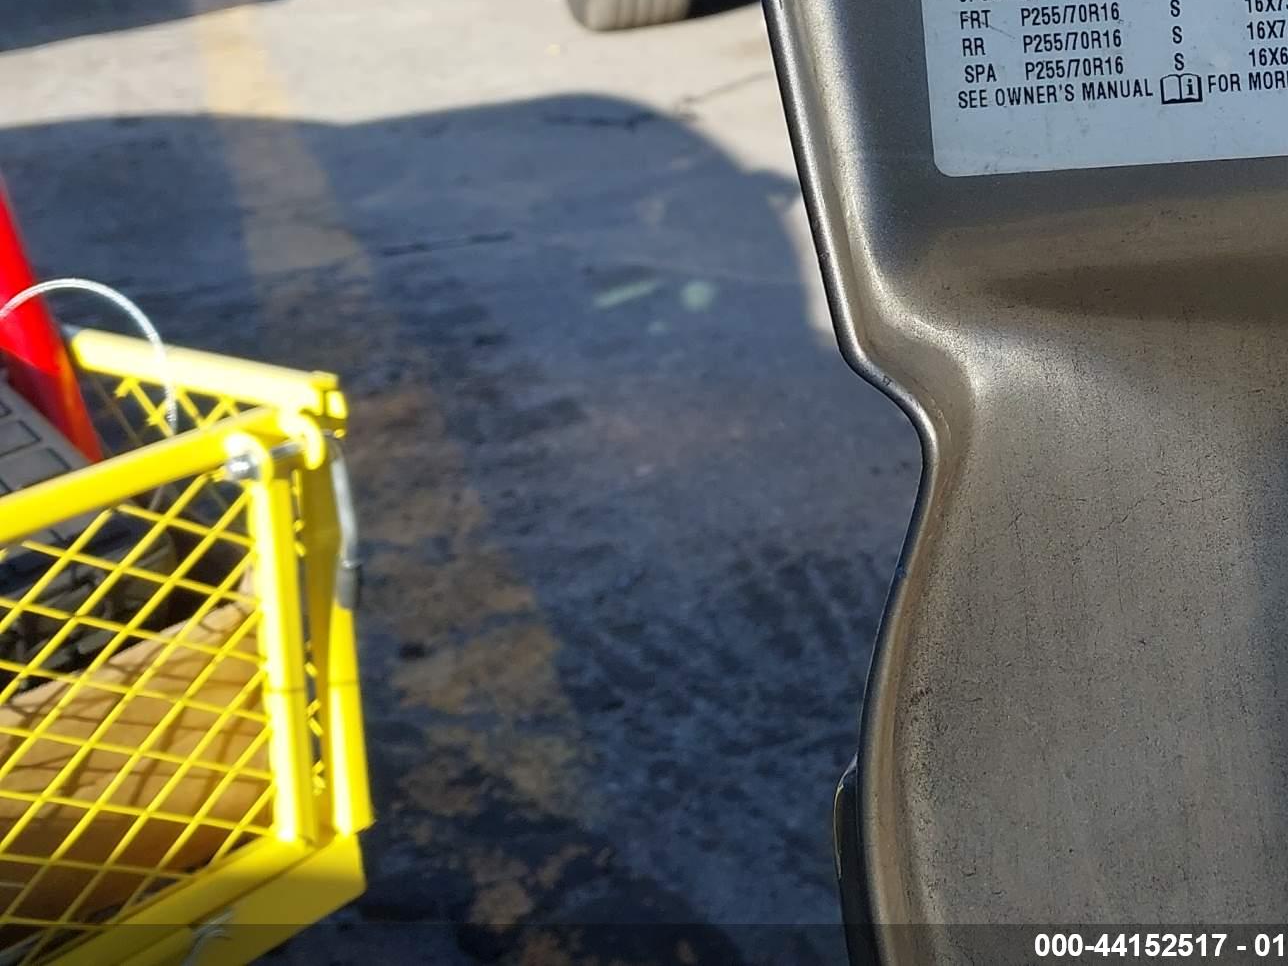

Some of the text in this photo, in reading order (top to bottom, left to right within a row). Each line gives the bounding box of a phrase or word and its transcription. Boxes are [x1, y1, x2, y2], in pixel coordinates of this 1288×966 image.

[1021, 2, 1120, 26] P255/70R16
[1170, 0, 1180, 17] S
[960, 10, 991, 30] FRT
[1023, 29, 1121, 53] P255/70R16
[1172, 26, 1182, 44] S
[962, 37, 985, 57] RR
[1025, 56, 1123, 80] P255/70R16
[1174, 53, 1184, 71] S
[965, 63, 997, 83] SPA
[958, 89, 988, 109] SEE
[995, 84, 1074, 106] OWNER'S
[1082, 79, 1153, 101] MANUAL
[1208, 74, 1241, 93] FOR
